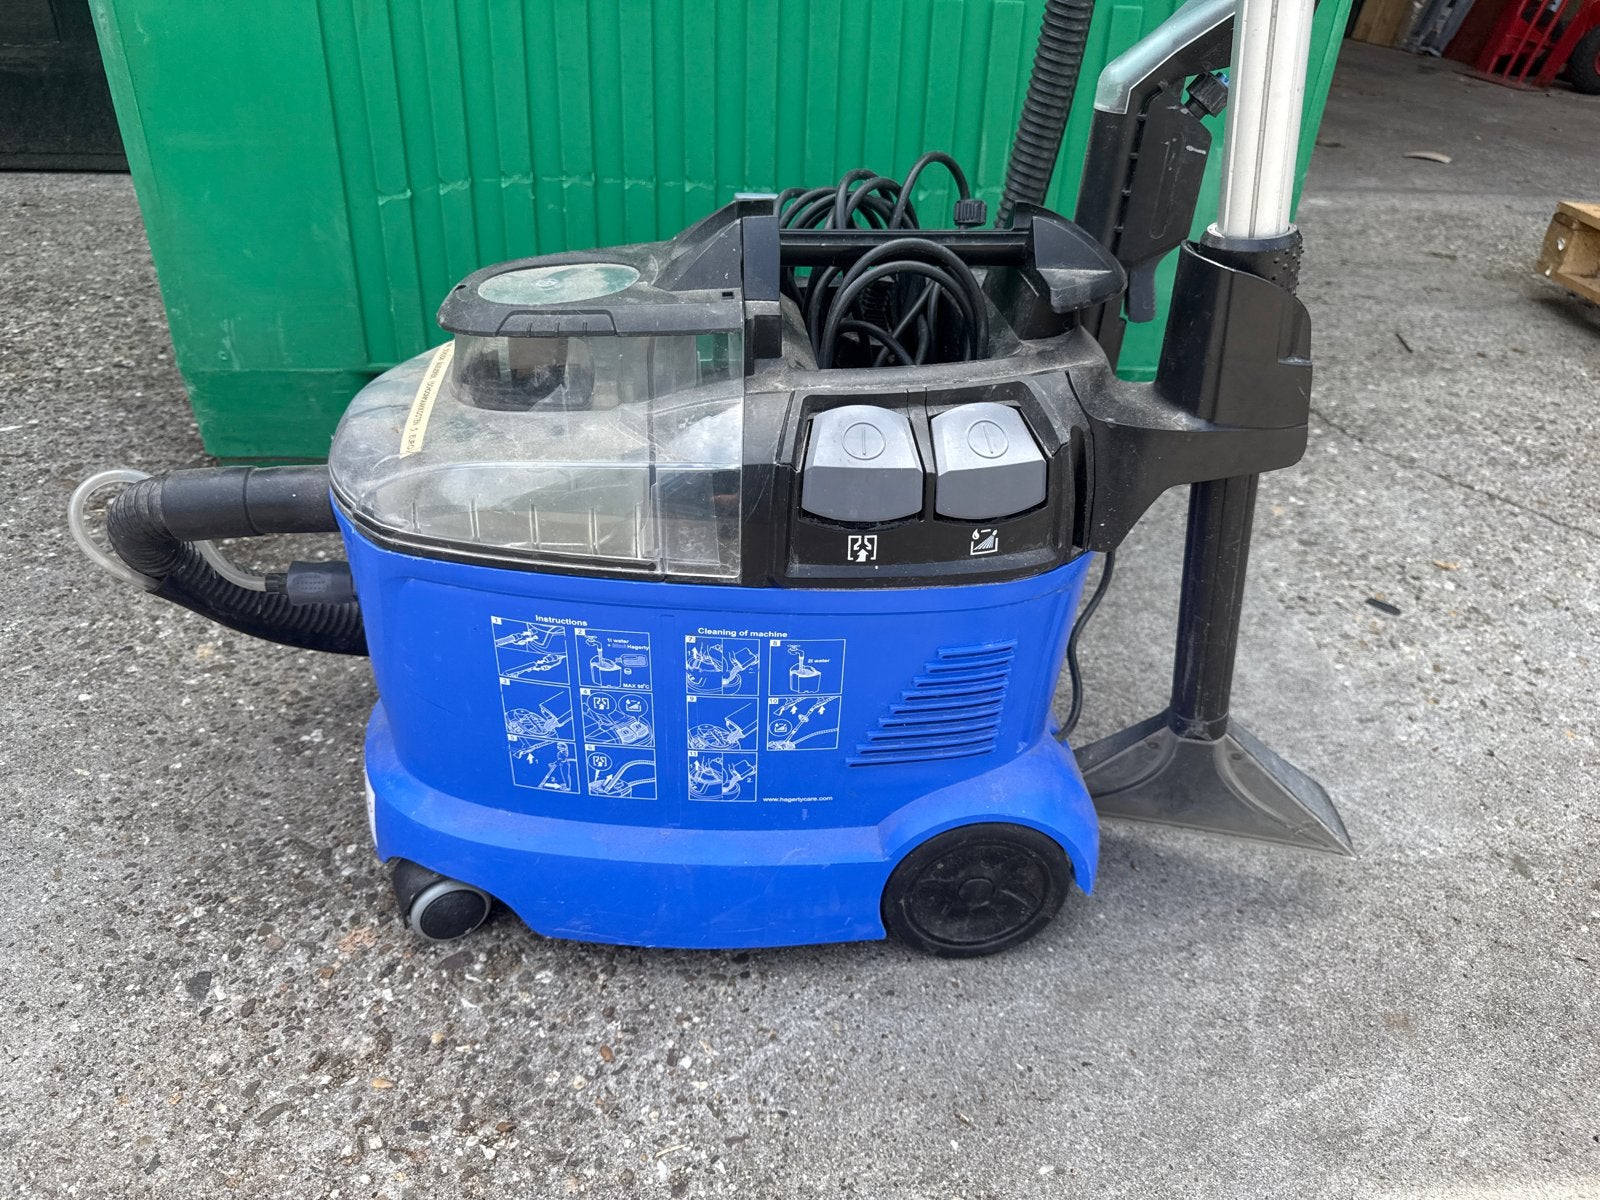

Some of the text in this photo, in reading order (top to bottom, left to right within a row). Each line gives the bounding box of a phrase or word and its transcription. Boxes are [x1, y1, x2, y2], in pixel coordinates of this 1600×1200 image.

[535, 614, 588, 627] Instructions
[697, 627, 737, 638] Cleaning
[738, 629, 749, 637] of
[626, 644, 650, 652] Hagerty
[762, 795, 834, 803] www.hagertycare.com
